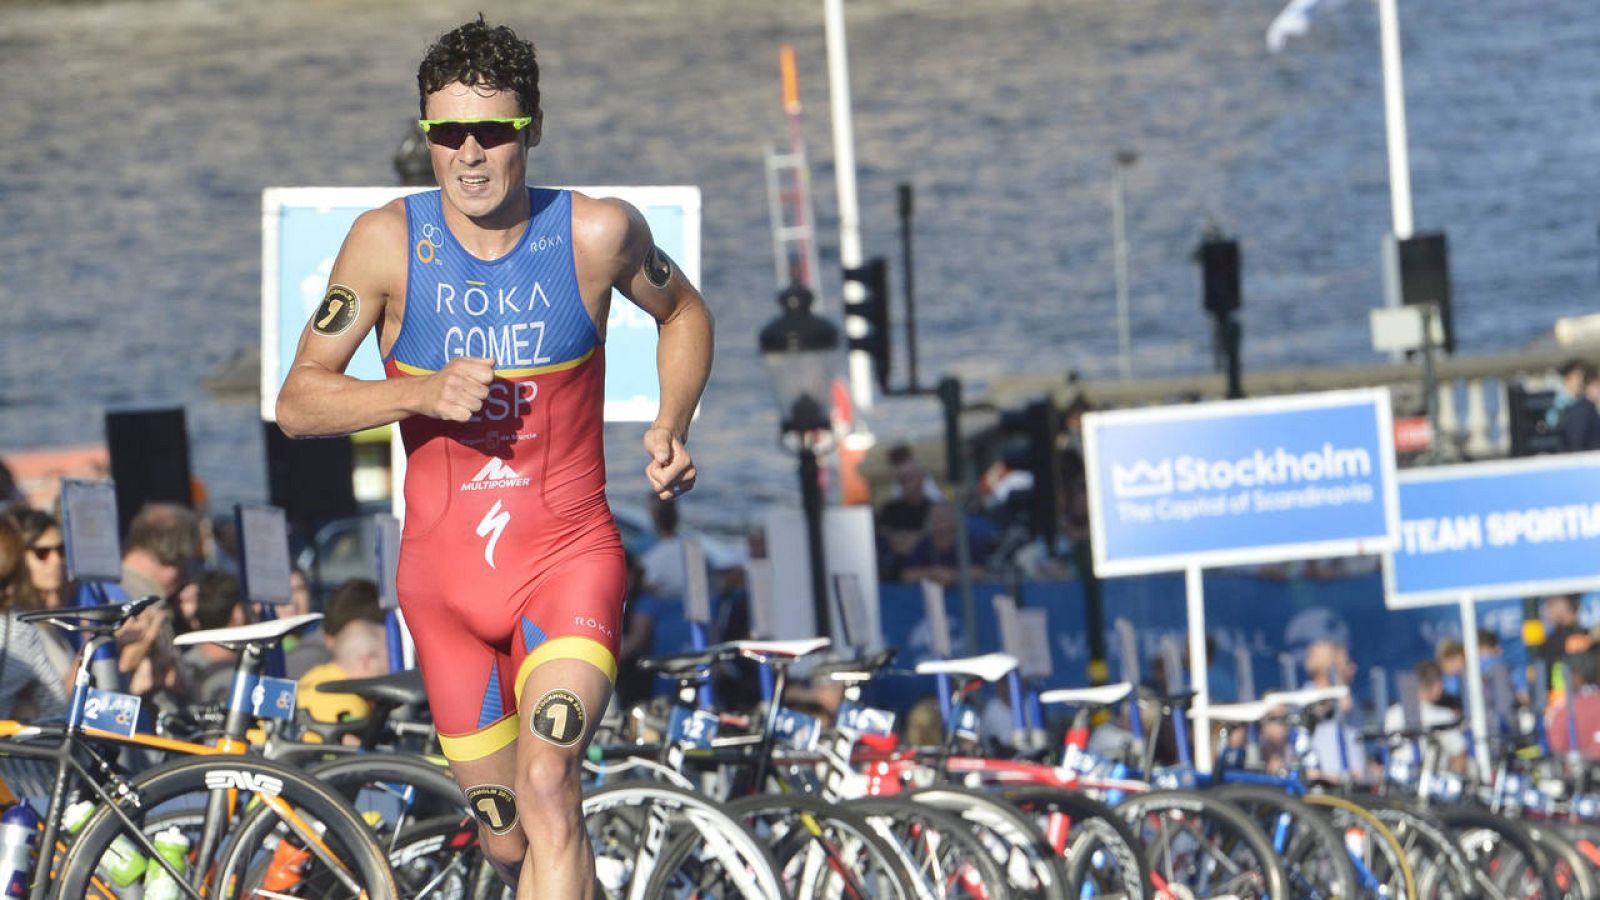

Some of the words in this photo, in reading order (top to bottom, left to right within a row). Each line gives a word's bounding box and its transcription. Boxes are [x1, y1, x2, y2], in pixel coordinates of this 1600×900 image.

[317, 299, 344, 329] 1
[444, 321, 550, 366] GOMEZ
[469, 380, 539, 422] SP
[460, 478, 530, 492] MULTIPOWER
[1174, 442, 1371, 492] Stockholm
[1118, 501, 1153, 522] The
[1156, 496, 1225, 521] Capital
[1229, 492, 1250, 514] of
[1254, 484, 1373, 512] Scandinavia
[1401, 513, 1482, 555] TEAM
[546, 703, 568, 740] 1
[476, 798, 503, 827] 1
